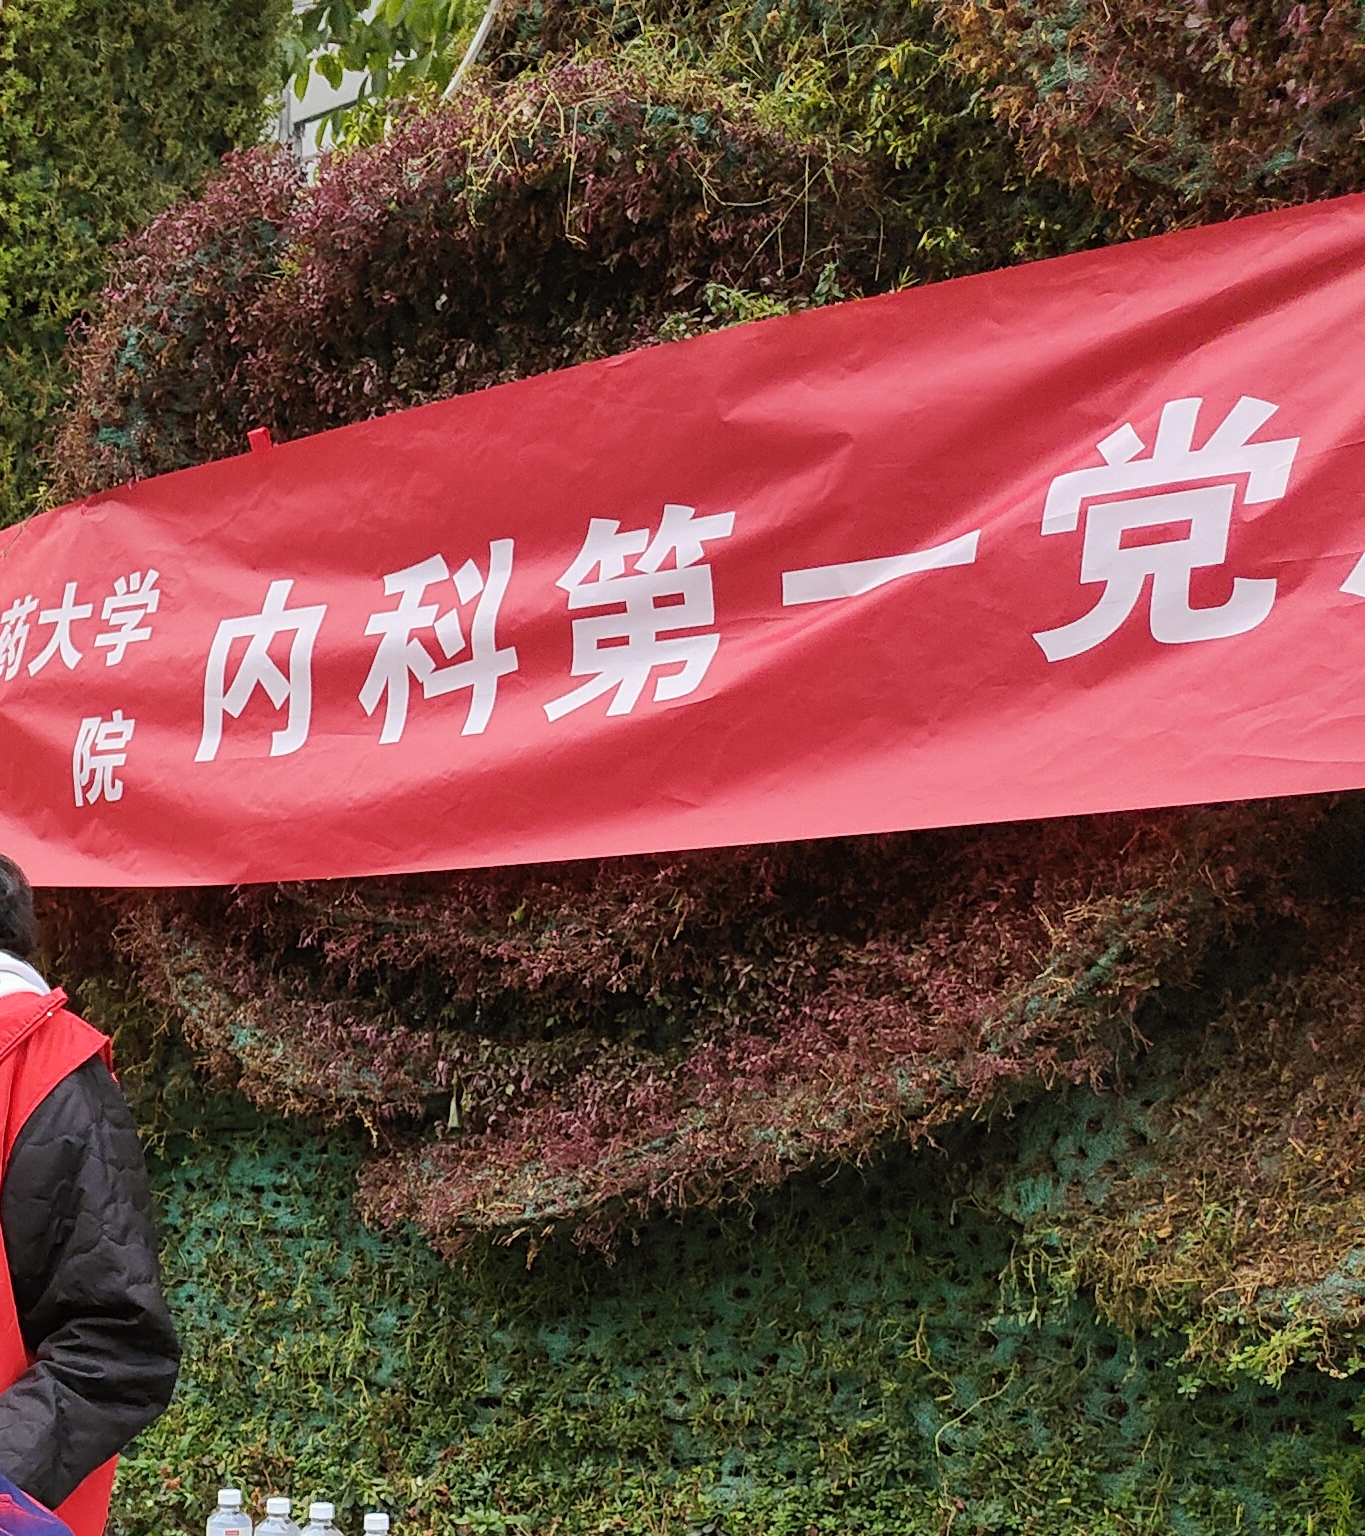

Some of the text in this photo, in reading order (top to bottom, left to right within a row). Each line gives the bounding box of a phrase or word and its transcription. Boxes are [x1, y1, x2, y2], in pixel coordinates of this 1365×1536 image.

[194, 396, 1365, 764] 内科第一党
